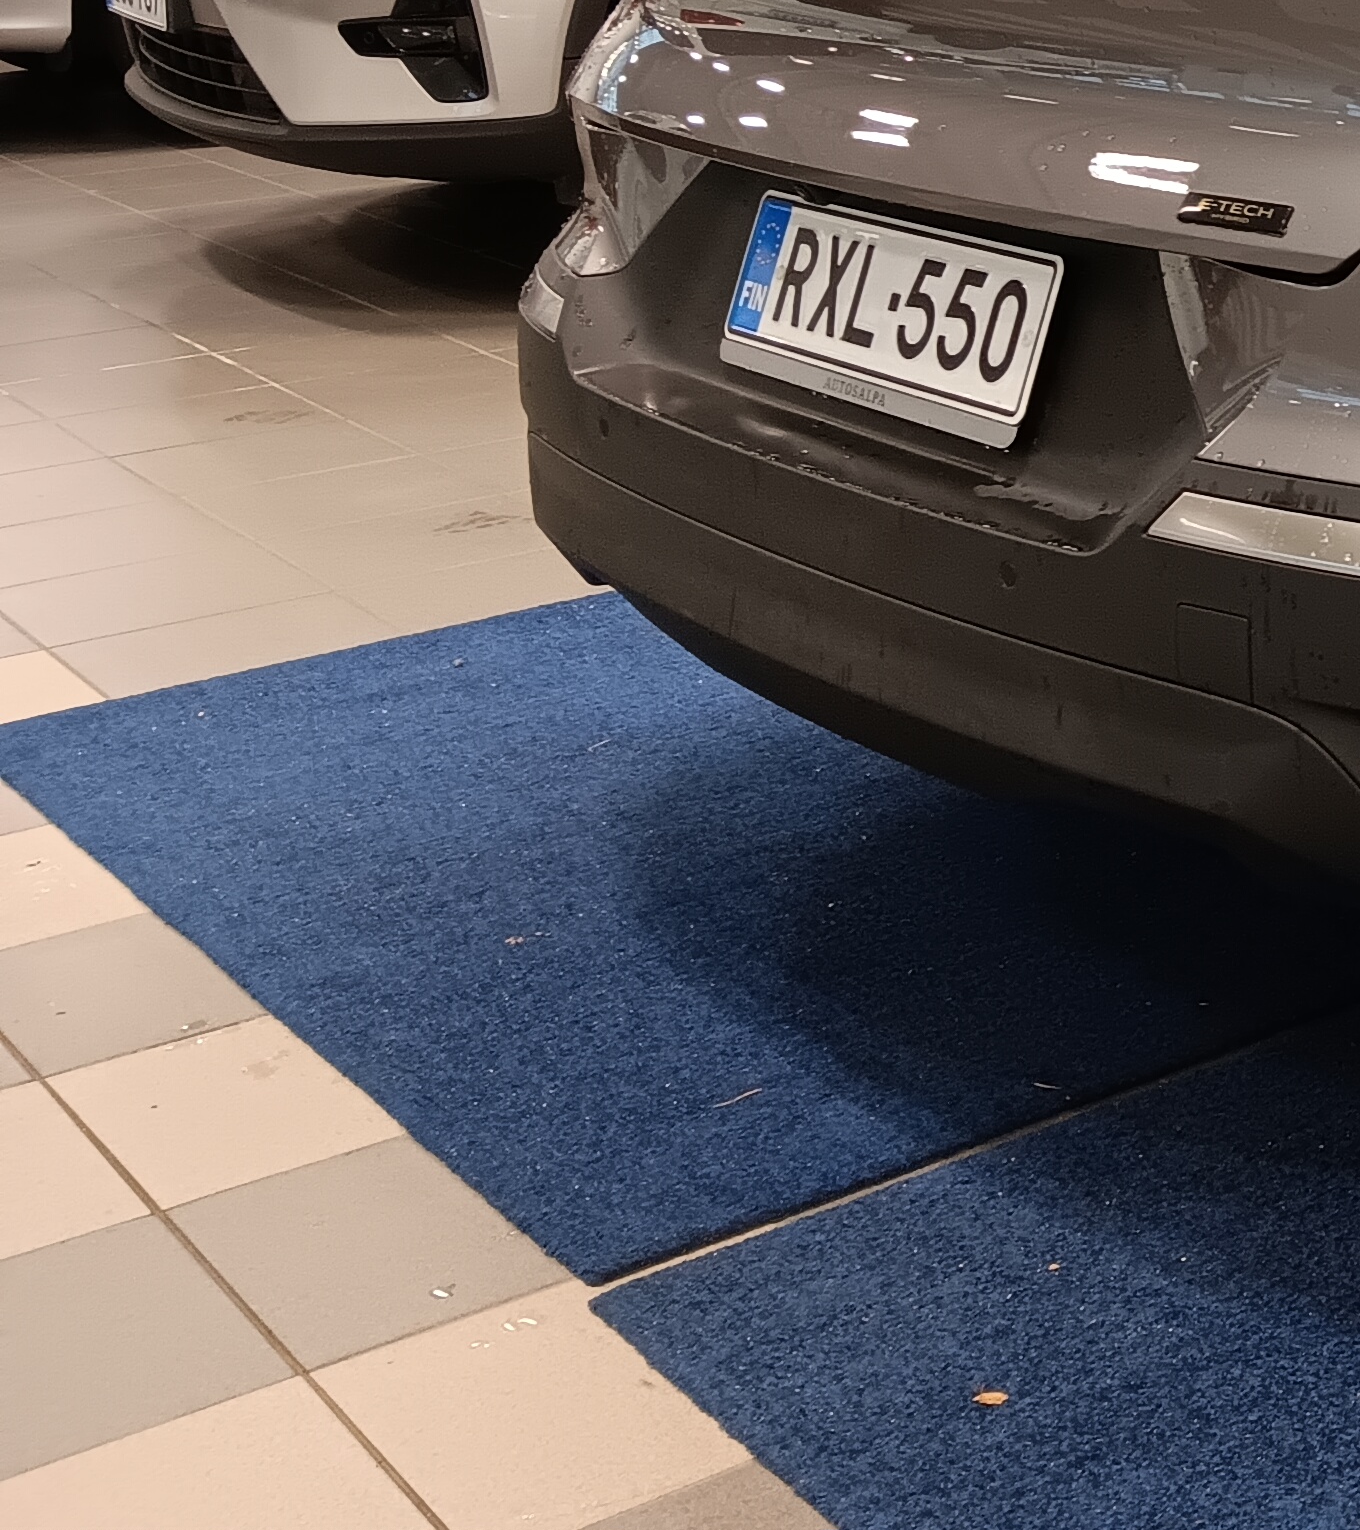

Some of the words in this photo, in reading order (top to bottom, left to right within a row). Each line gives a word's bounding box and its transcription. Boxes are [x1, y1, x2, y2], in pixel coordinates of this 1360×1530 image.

[1198, 197, 1275, 219] E-TECH
[738, 280, 769, 312] FIN
[771, 226, 1028, 384] RXL-550
[822, 376, 886, 407] AUTOSALPA
